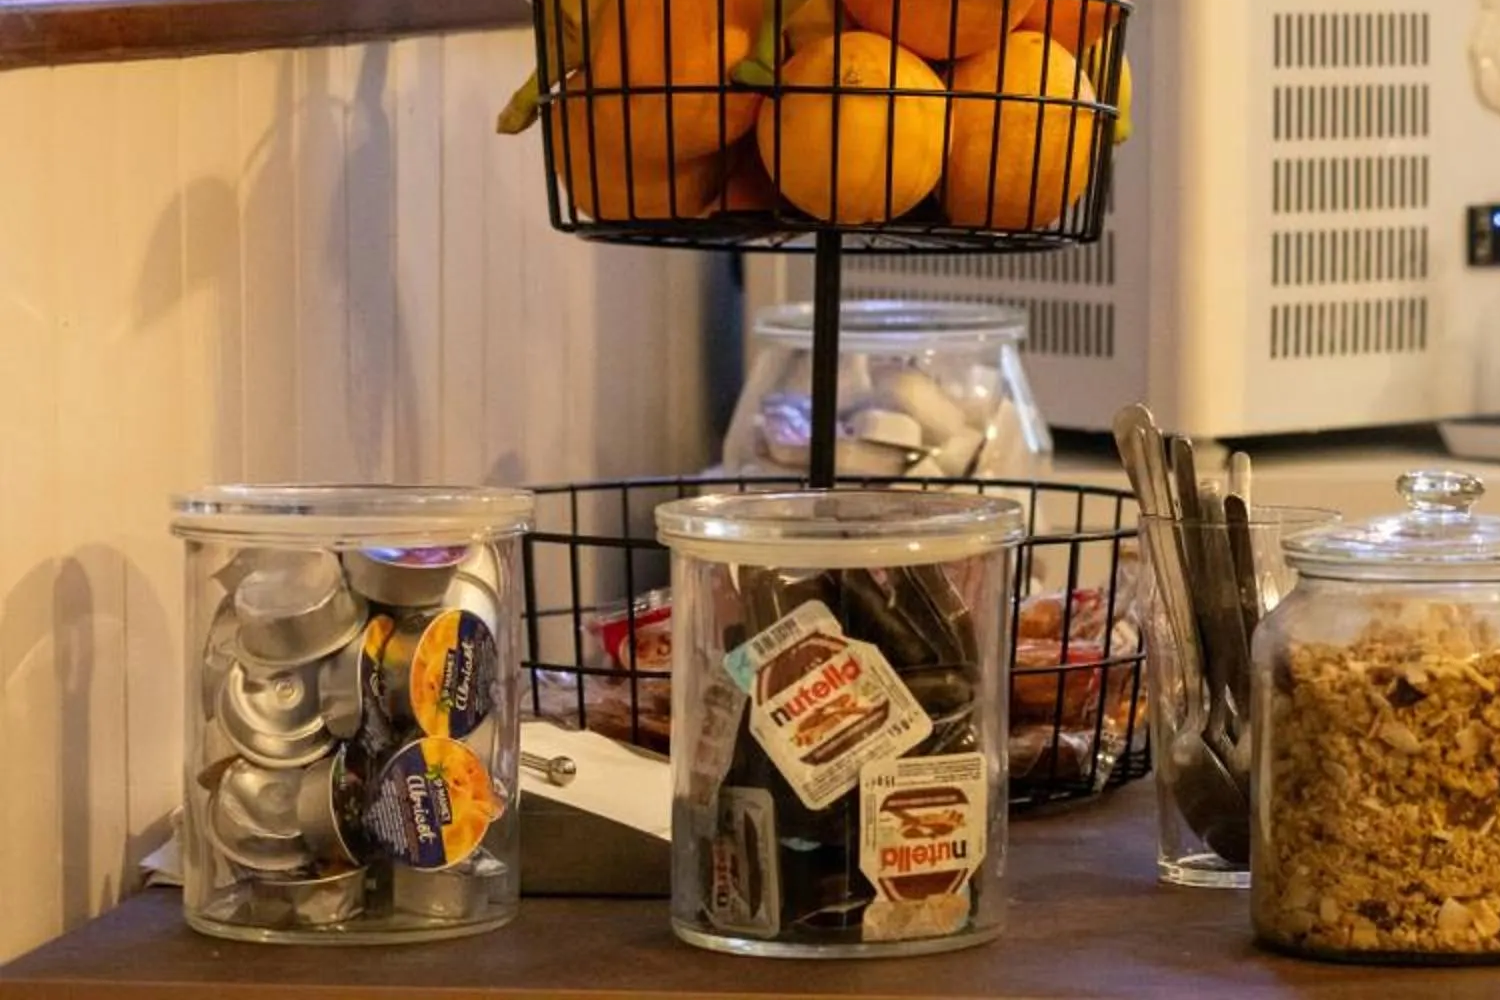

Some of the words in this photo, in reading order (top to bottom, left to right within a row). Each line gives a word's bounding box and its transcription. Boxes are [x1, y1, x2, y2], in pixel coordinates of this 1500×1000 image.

[769, 655, 862, 727] nutella
[406, 775, 437, 844] Abricot
[880, 839, 967, 872] nutella
